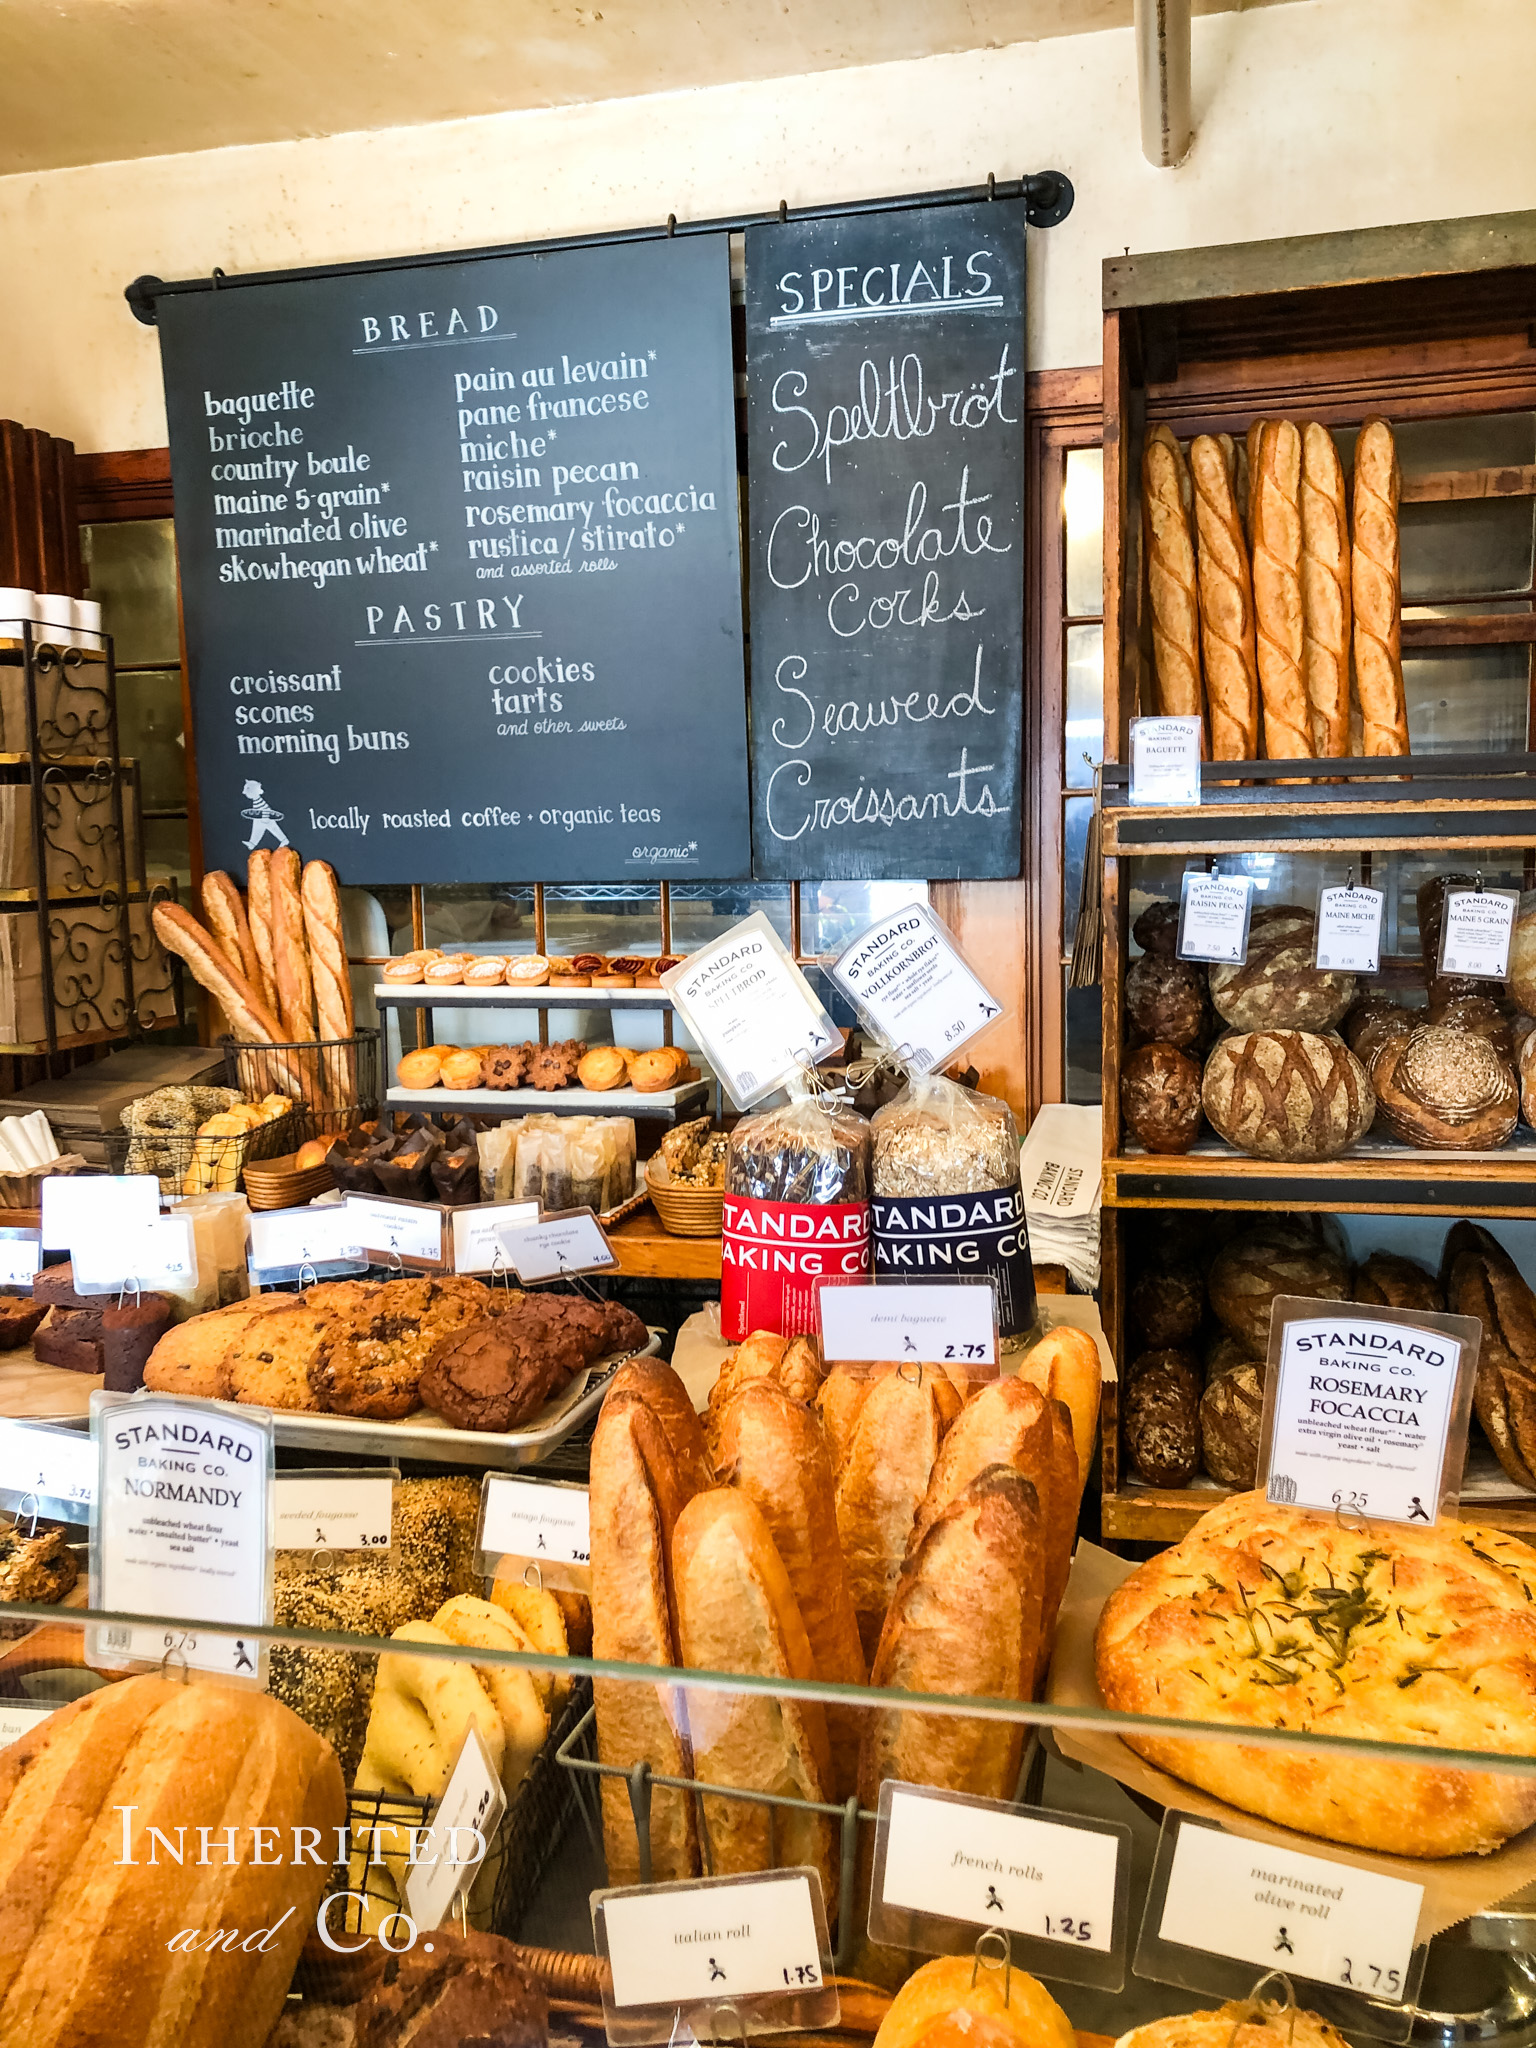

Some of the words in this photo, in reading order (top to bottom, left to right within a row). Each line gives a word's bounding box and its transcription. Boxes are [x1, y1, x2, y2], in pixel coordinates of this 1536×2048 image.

[779, 251, 993, 313] SPECIALS
[362, 304, 500, 344] BREAD
[455, 368, 516, 402] pain
[522, 369, 554, 389] au
[204, 381, 315, 426] baguette
[458, 402, 521, 438] pane
[526, 388, 649, 421] francese
[209, 423, 304, 453] brioche
[211, 456, 298, 488] country
[308, 445, 370, 476] boule
[462, 464, 541, 492] raisin
[552, 458, 639, 495] pecan
[214, 490, 288, 515] maine
[465, 500, 594, 530] rosemary
[602, 485, 717, 517] focaccia
[216, 518, 342, 549] marinated
[350, 513, 408, 540] olive
[768, 465, 1011, 588] Chocolate
[219, 548, 352, 588] skowhegan
[476, 564, 504, 579] and
[511, 559, 572, 577] assorted
[578, 557, 618, 574] rolls
[366, 594, 525, 635] PASTRY
[828, 571, 986, 637] Corks
[230, 664, 343, 696] croissant
[489, 657, 595, 686] cookies
[491, 687, 564, 716] tarts
[772, 644, 995, 749] Seaweed
[235, 701, 315, 726] scones
[497, 719, 528, 736] and
[534, 717, 573, 735] other
[578, 717, 627, 734] sweets
[238, 727, 340, 763] morning
[347, 725, 410, 752] buns
[1140, 724, 1193, 736] SNDARD
[767, 746, 1011, 840] Croissants
[309, 807, 370, 836] locally
[382, 807, 452, 830] roasted
[462, 806, 521, 829] coffee
[539, 806, 614, 832] organic
[620, 803, 662, 824] teas
[1190, 900, 1217, 909] RAISIN
[1218, 901, 1245, 911] PECAN
[1192, 884, 1244, 898] STANDARD
[1326, 892, 1378, 905] STANDARD
[1454, 898, 1509, 911] STANDARD
[1325, 911, 1349, 920] MAINE
[1350, 912, 1375, 921] MICHE
[1449, 914, 1475, 923] MAINE
[1482, 916, 1509, 926] GRAIN
[848, 918, 921, 979] STANDARD
[867, 949, 900, 977] BAKING
[687, 942, 763, 998] STANDARD
[861, 934, 940, 1001] VOLLKORNBROT
[705, 971, 738, 997] BAKING
[943, 1019, 966, 1042] 8.50
[1037, 1162, 1060, 1189] BAKING
[1057, 1168, 1083, 1205] STANDARD
[723, 1203, 870, 1239] TANDARD
[873, 1189, 1024, 1229] TANDARD
[722, 1245, 823, 1274] AKING
[875, 1240, 980, 1266] AKING
[944, 1343, 986, 1359] 2.75
[1296, 1332, 1445, 1367] STANDARD
[1319, 1357, 1381, 1373] BAKING
[1389, 1365, 1416, 1377] CO.
[1309, 1375, 1429, 1404] ROSEMARY
[1309, 1399, 1420, 1426] FOCACCIA
[115, 1422, 253, 1464] STANDARD
[1298, 1418, 1342, 1430] unbleached
[1344, 1422, 1367, 1433] wheat
[1405, 1432, 1427, 1441] water
[1298, 1427, 1316, 1436] extra
[1318, 1429, 1342, 1440] virgin
[1343, 1432, 1361, 1441] olive
[1338, 1441, 1357, 1451] yeast
[1366, 1445, 1380, 1453] salt
[138, 1456, 196, 1473] BAKING
[203, 1464, 228, 1477] CO.
[124, 1478, 243, 1508] NORMANDY
[313, 1510, 358, 1521] fougasse
[360, 1534, 387, 1546] 3.00
[163, 1630, 197, 1650] 6.75
[950, 1848, 1003, 1875] french
[1008, 1863, 1043, 1882] rolls
[1250, 1866, 1344, 1901] marinated
[1254, 1889, 1296, 1911] olive
[1299, 1901, 1331, 1920] roll
[674, 1928, 723, 1945] italian
[726, 1924, 751, 1941] roll
[1044, 1915, 1092, 1941] 1.25
[783, 1964, 818, 1984] 1.75
[1340, 1957, 1400, 1994] 2.75
